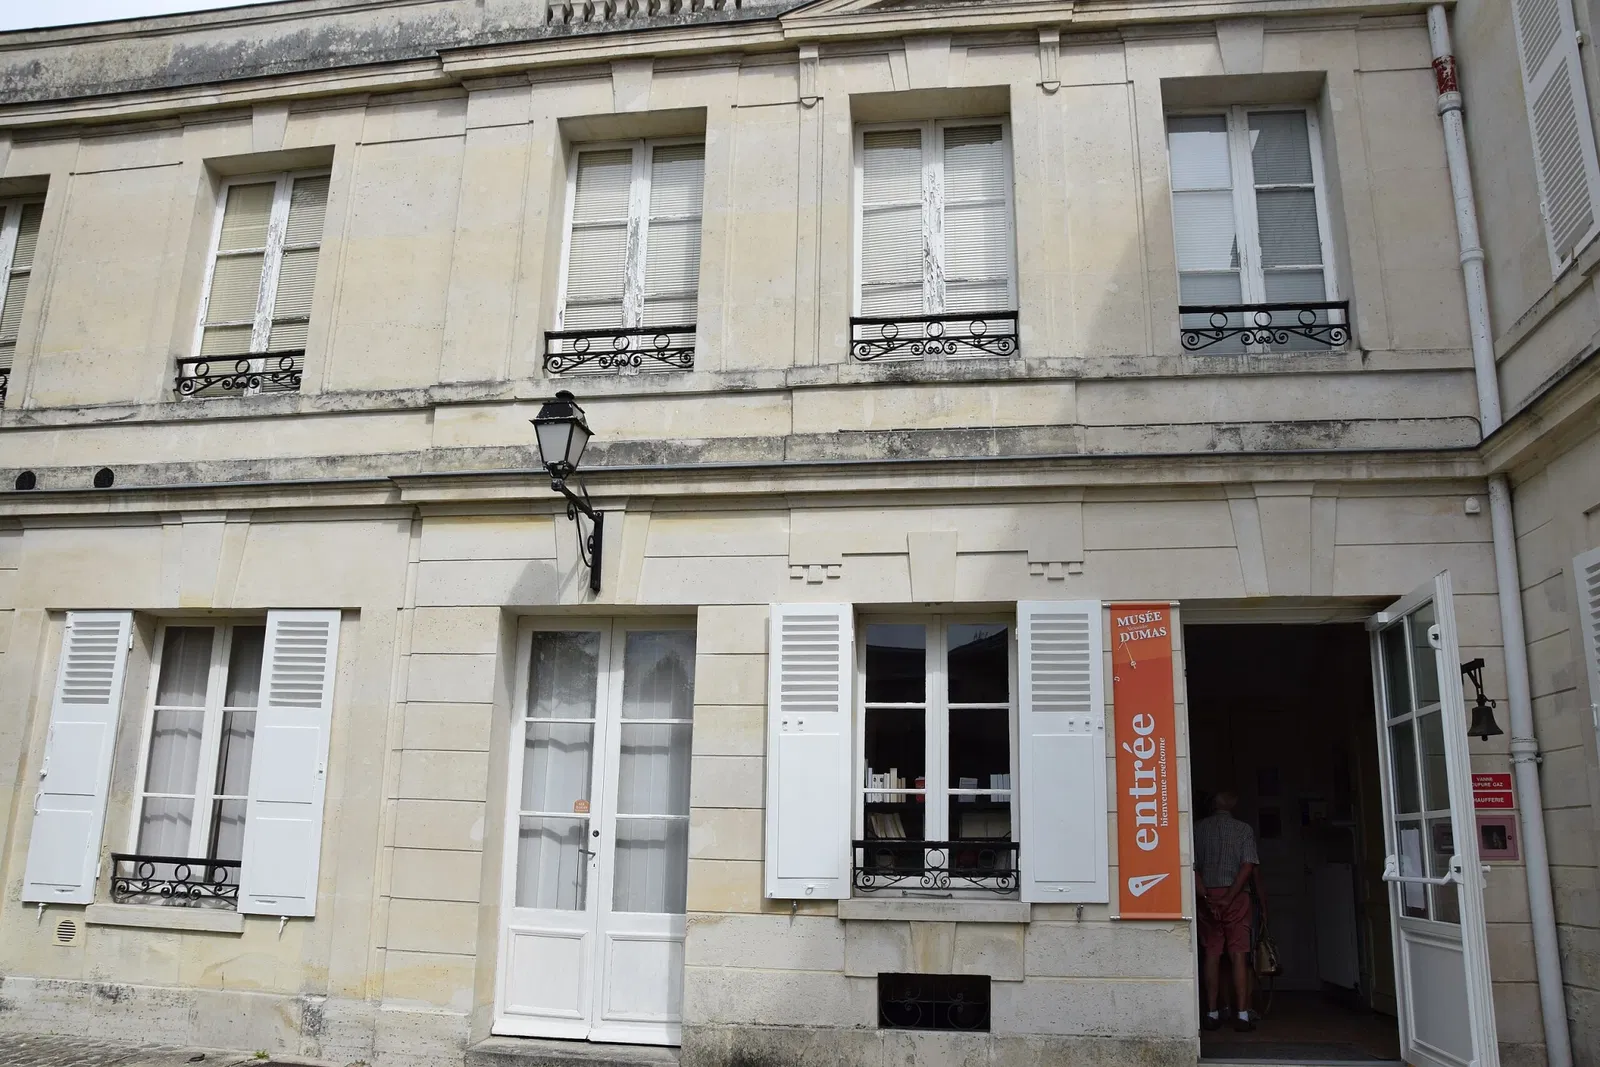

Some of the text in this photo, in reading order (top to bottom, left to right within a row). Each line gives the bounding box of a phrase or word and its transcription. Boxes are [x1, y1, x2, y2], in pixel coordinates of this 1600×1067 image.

[1117, 610, 1162, 627] MUSÉE
[1120, 627, 1167, 642] DUMAS
[1122, 713, 1159, 851] entrée
[1158, 737, 1169, 827] bienvenue welcome
